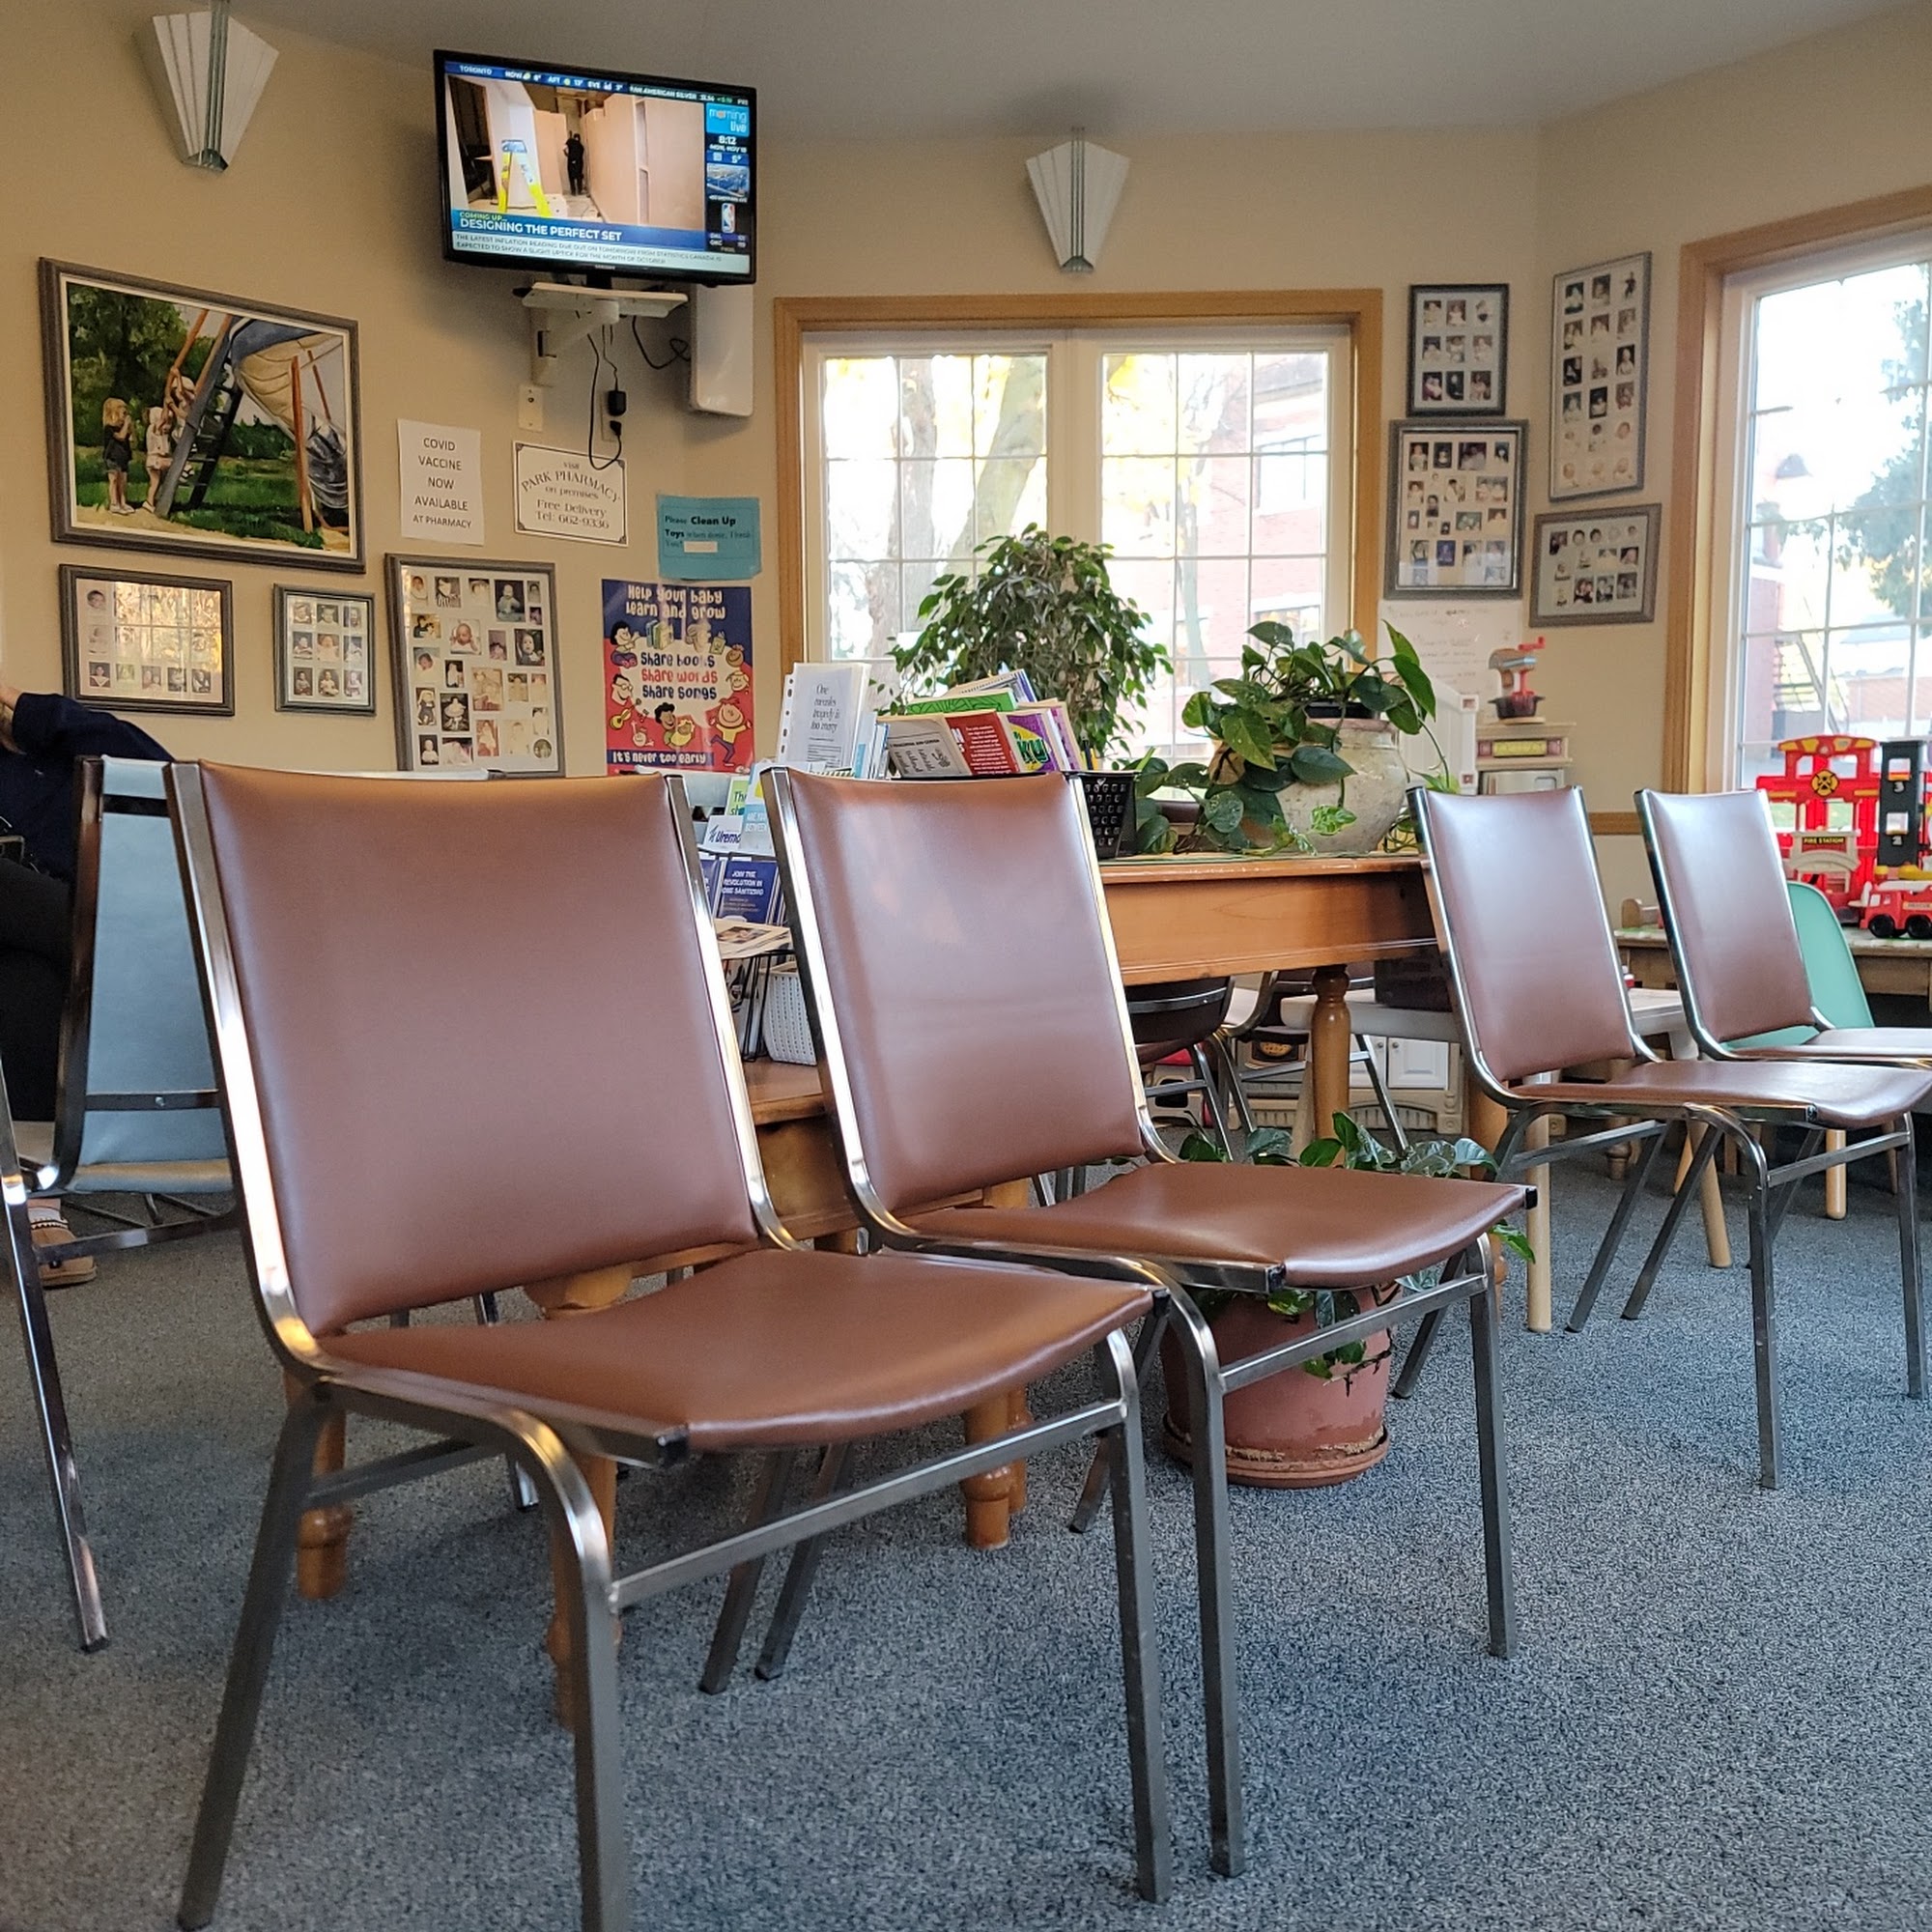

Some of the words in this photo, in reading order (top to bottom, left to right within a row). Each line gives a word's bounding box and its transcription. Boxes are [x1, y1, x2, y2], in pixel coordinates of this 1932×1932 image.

[459, 65, 492, 75] TORONTO
[642, 87, 675, 98] AMERICAN
[709, 108, 747, 124] morning
[730, 121, 747, 132] live
[718, 135, 737, 145] 8:12
[460, 212, 490, 221] COMING
[460, 218, 523, 233] DESIGNING
[525, 223, 548, 236] THE
[550, 226, 600, 240] PERFECT
[601, 231, 622, 242] SET
[598, 246, 637, 255] TOMORROW
[423, 438, 455, 451] COVID
[418, 455, 462, 470] VACCINE
[428, 476, 454, 489] NOW
[521, 470, 552, 493] PARK
[554, 470, 620, 503] PHARMACY
[560, 487, 599, 499] premises
[414, 496, 469, 511] AVAILABLE
[537, 498, 560, 509] Free
[564, 503, 607, 518] Delivery
[412, 514, 423, 524] AT
[425, 515, 471, 528] PHARMACY
[536, 511, 555, 522] Tel:
[558, 514, 610, 529] 662-9336
[691, 516, 720, 526] Clean
[722, 516, 736, 527] Up
[665, 528, 685, 539] Toys
[628, 584, 652, 601] Help
[656, 587, 686, 602] your
[691, 590, 723, 604] baby
[663, 604, 686, 618] and
[692, 606, 725, 620] grow
[676, 655, 715, 668] boos
[816, 683, 829, 695] One
[612, 752, 631, 763] It's
[632, 753, 657, 763] never
[660, 753, 676, 764] too
[678, 753, 706, 764] early
[1893, 781, 1904, 793] 3
[723, 878, 755, 887] REVOLUTION
